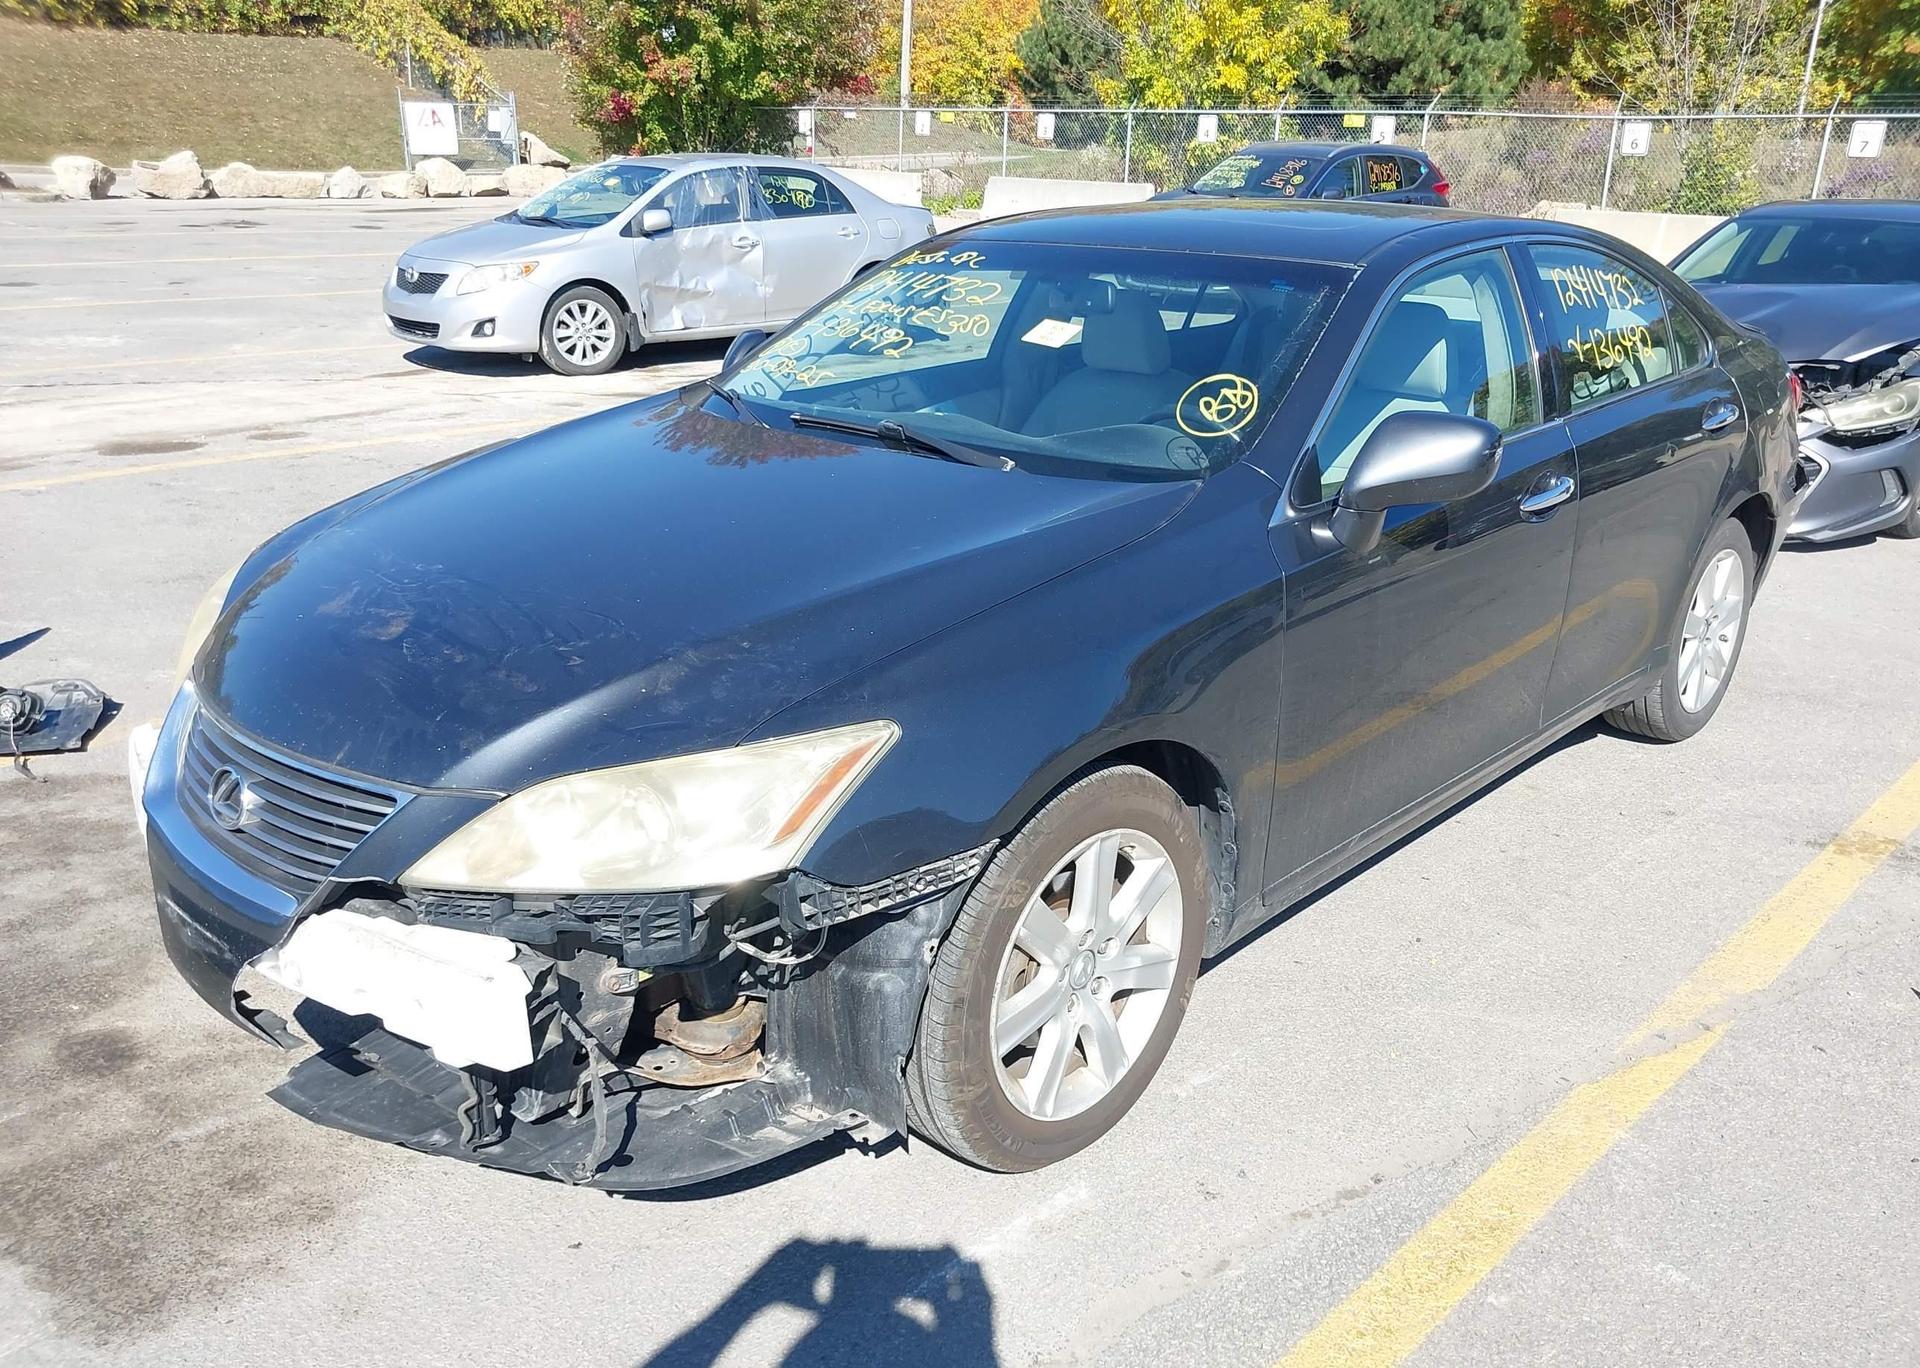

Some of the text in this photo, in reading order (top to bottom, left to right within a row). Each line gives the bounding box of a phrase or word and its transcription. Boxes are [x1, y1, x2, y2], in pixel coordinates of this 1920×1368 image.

[1631, 138, 1639, 150] 6
[1860, 140, 1869, 153] 7
[1551, 265, 1645, 314] 12414732
